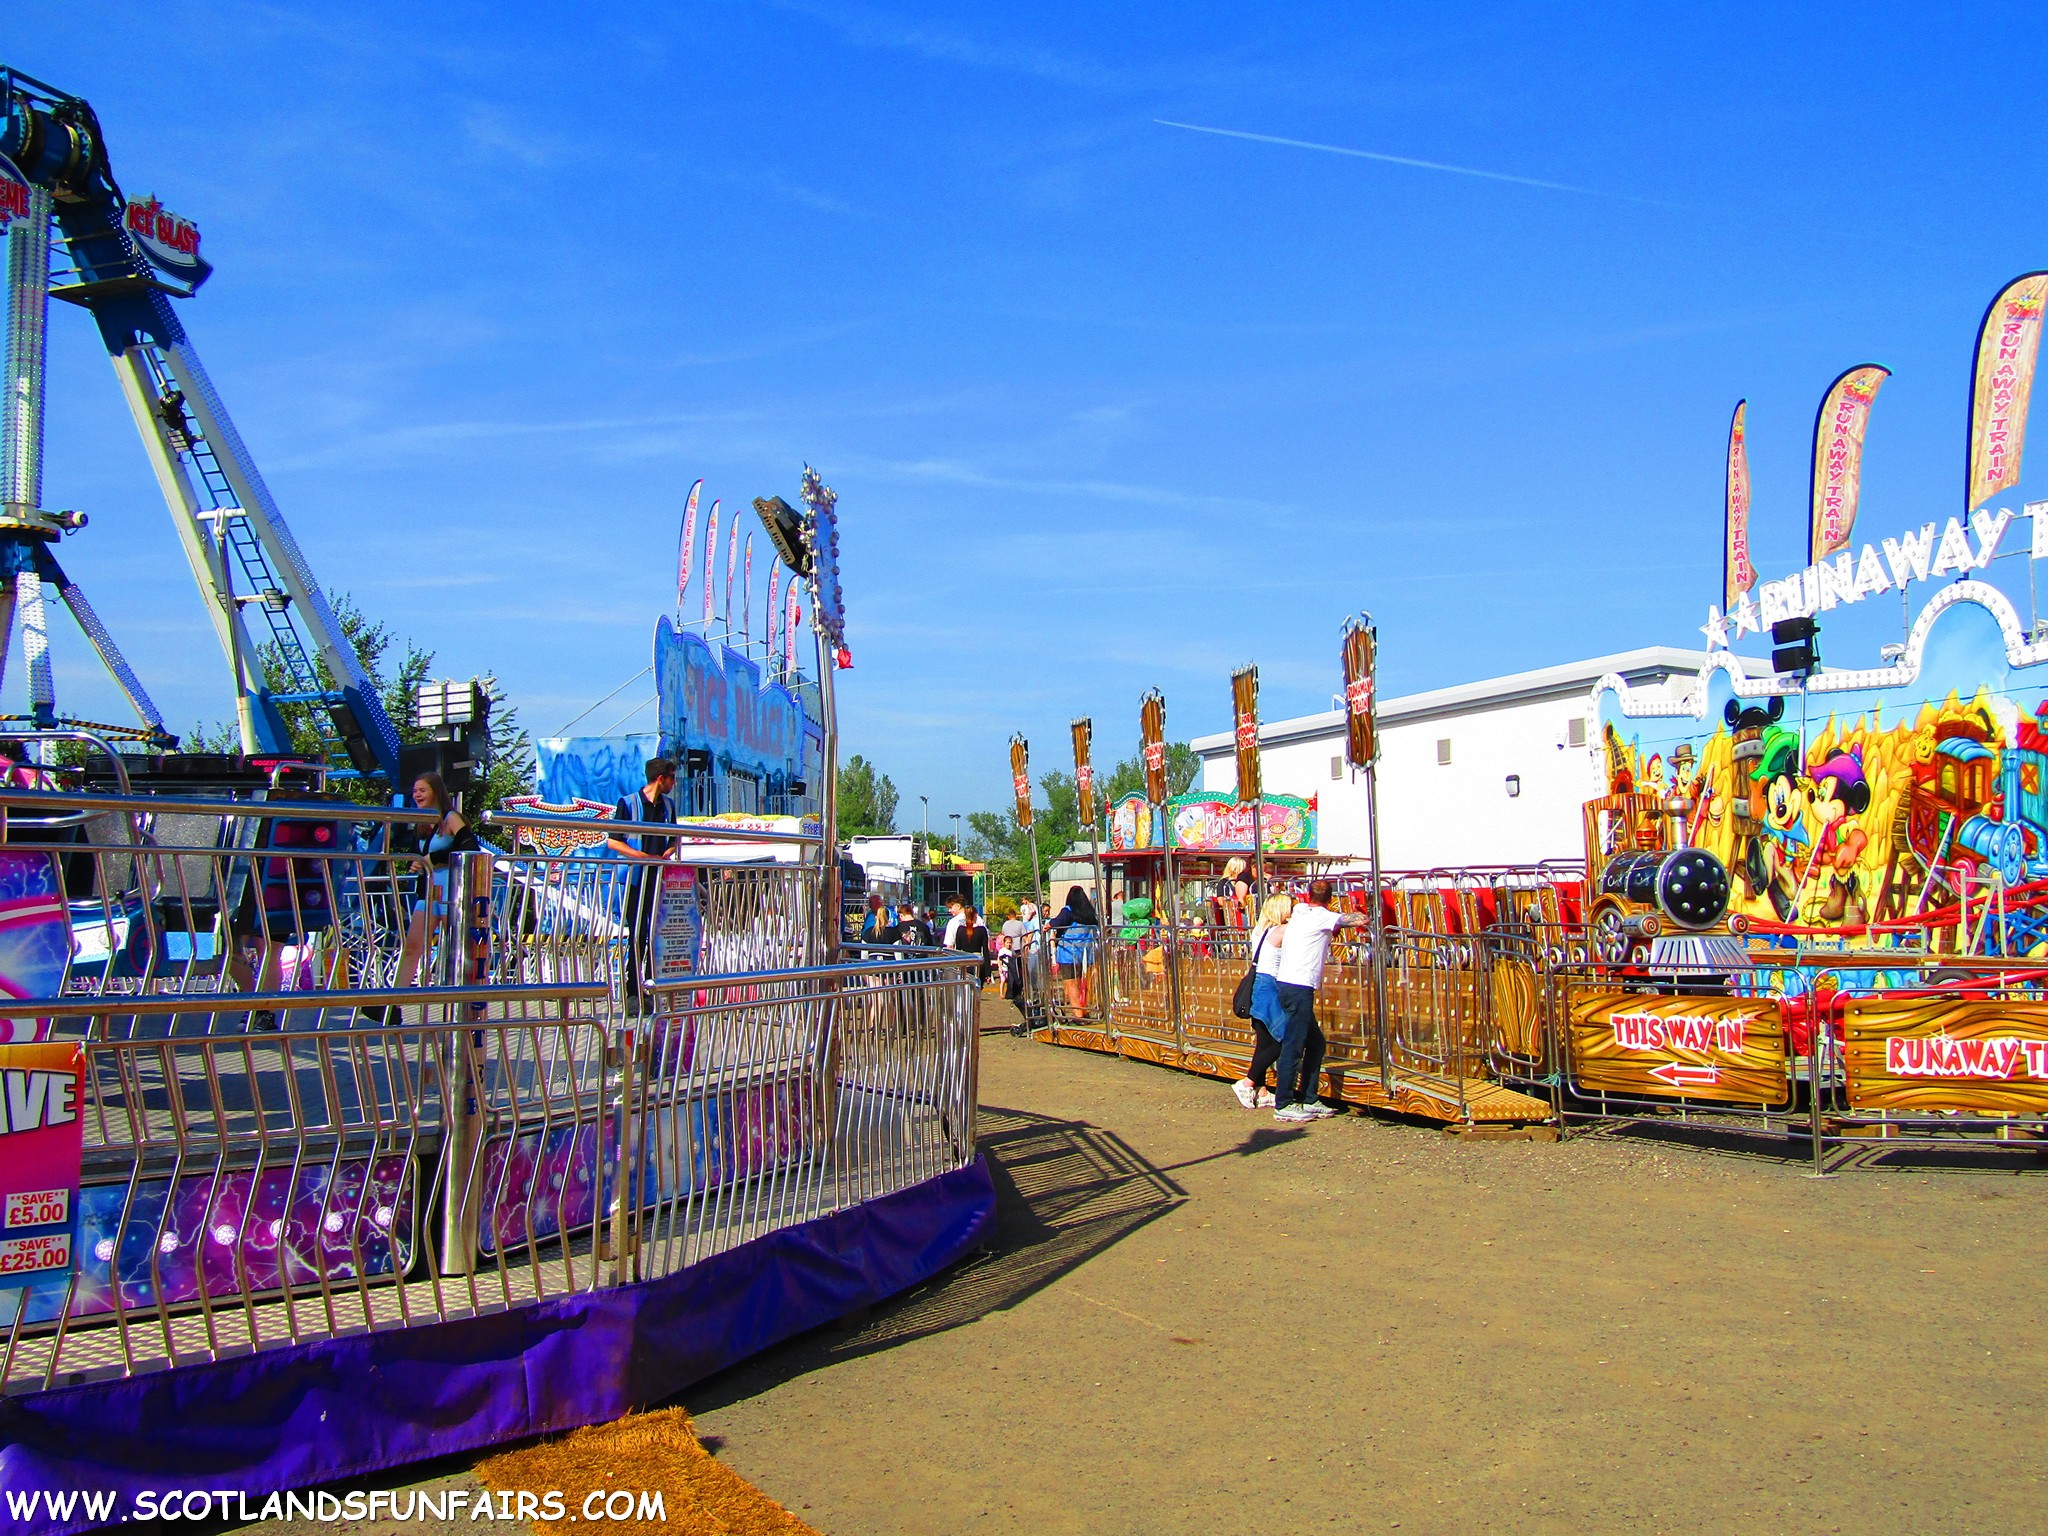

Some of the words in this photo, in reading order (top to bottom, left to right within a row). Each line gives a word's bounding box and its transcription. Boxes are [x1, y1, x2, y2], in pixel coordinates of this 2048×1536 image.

[128, 203, 155, 239] ICE
[157, 213, 201, 256] BLAST
[1987, 418, 2009, 481] TRAIN
[686, 511, 694, 537] ICE
[1824, 486, 1843, 542] TRAIN
[1733, 529, 1748, 583] TRAIN
[1759, 507, 2014, 633] RUNAWAY
[697, 665, 727, 739] ICE
[1241, 713, 1252, 726] FOR
[1237, 723, 1256, 740] YOUNG
[1205, 811, 1227, 841] Play
[1229, 811, 1267, 829] Statin
[1231, 830, 1245, 841] Las
[1245, 829, 1270, 841] Veas
[1610, 1014, 1665, 1049] THIS
[1666, 1015, 1714, 1052] WAY
[1717, 1017, 1743, 1053] IN
[1886, 1036, 2019, 1079] RUNAWAY
[2021, 1040, 2048, 1078] T
[9, 1202, 65, 1226] £5.00
[0, 1248, 67, 1273] £25.00
